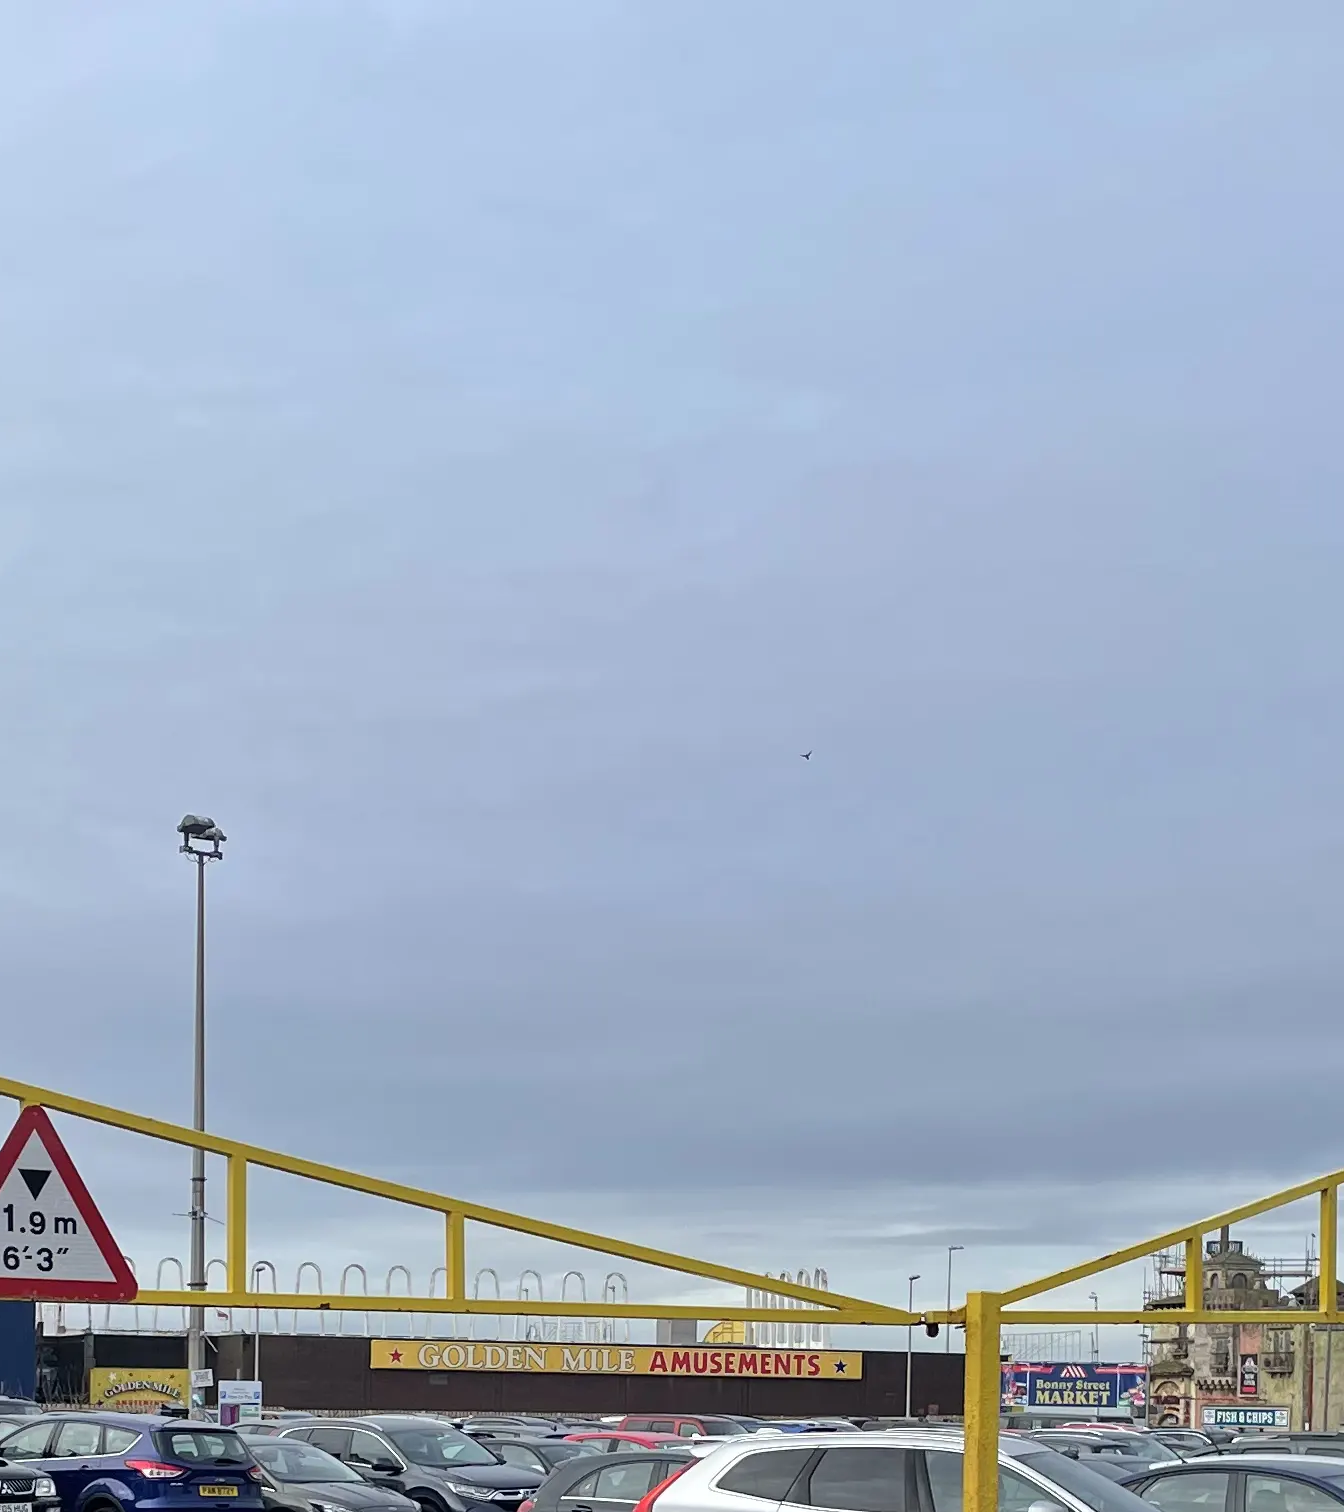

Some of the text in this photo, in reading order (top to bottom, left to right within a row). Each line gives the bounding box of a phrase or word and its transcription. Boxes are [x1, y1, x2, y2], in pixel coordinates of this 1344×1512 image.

[3, 1203, 46, 1235] 1.9
[418, 1344, 821, 1376] GOLDEN MILE AMUSEMENTS
[104, 1380, 181, 1399] GOLDEN MILE
[1036, 1379, 1110, 1392] Bonny Street
[1035, 1391, 1110, 1405] MARKET
[1216, 1411, 1237, 1423] FISH
[1238, 1411, 1245, 1424] &
[1246, 1411, 1273, 1424] CHIPS
